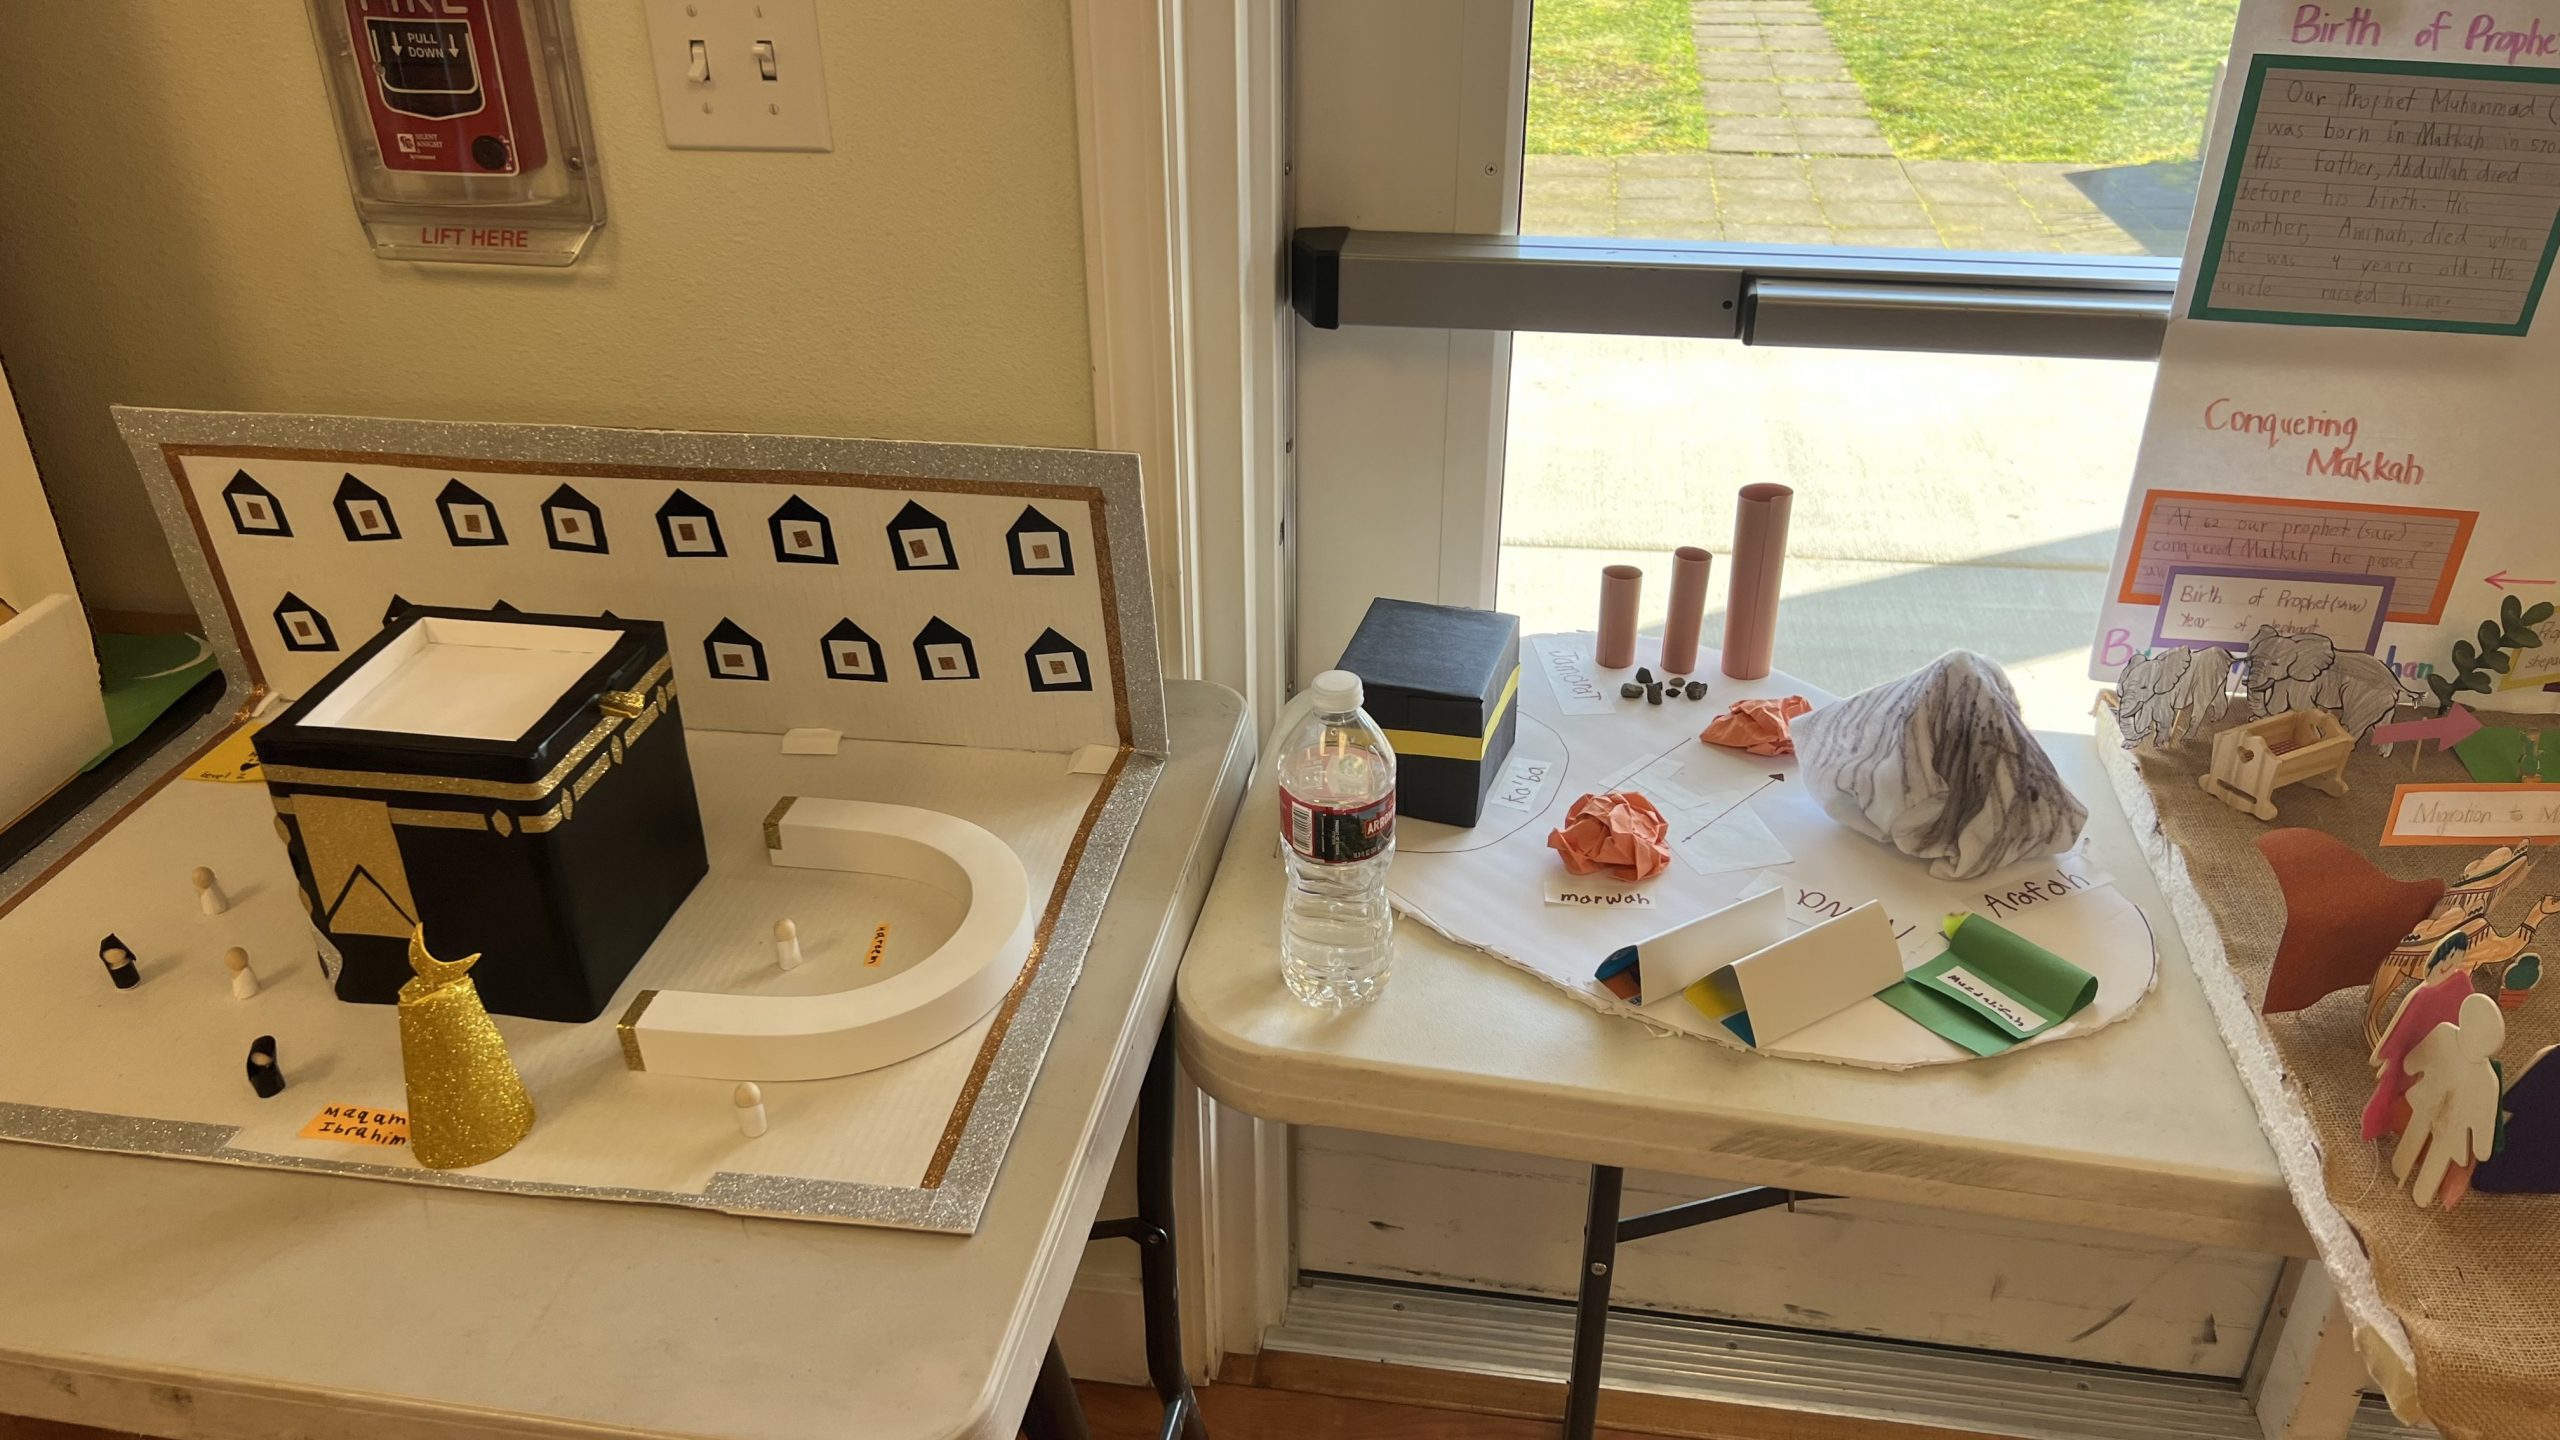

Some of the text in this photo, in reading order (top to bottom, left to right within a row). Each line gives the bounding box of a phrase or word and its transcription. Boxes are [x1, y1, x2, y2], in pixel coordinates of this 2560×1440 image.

[407, 32, 438, 44] PULL
[2291, 4, 2560, 64] Birth of Prophe
[408, 46, 444, 58] DOWN
[2287, 80, 2326, 106] Our
[2345, 83, 2416, 118] Prophet
[2431, 88, 2536, 118] Muhammad
[2267, 122, 2304, 138] was
[2323, 116, 2369, 142] born
[2504, 132, 2520, 152] in
[2255, 144, 2283, 171] His
[2387, 155, 2467, 182] Abdullah
[2477, 161, 2521, 183] died
[2239, 180, 2301, 204] before
[2322, 183, 2349, 206] his
[2446, 190, 2470, 214] His
[421, 227, 529, 248] LIFT HERE
[2236, 212, 2310, 244] mother,
[2423, 220, 2468, 246] died
[2488, 228, 2527, 250] when
[2227, 241, 2246, 263] he
[2266, 253, 2296, 267] was
[2361, 260, 2413, 278] years
[2491, 258, 2514, 280] His
[2222, 275, 2272, 297] uncle
[2321, 281, 2377, 304] raised
[2204, 398, 2359, 450] Conquering
[2306, 447, 2425, 485] Makkah
[2168, 506, 2192, 531] At
[2237, 519, 2270, 533] our
[2281, 517, 2350, 543] prophet
[2241, 538, 2308, 562] Makkah
[2330, 546, 2352, 564] he
[2365, 551, 2418, 575] passed
[2179, 585, 2222, 605] Birth
[2248, 586, 2268, 606] of
[2180, 612, 2321, 634] Year of lephant
[2409, 801, 2492, 834] Migration
[1560, 890, 1650, 906] marwah
[1984, 869, 2090, 919] Arafah
[318, 1121, 406, 1145] Ibrahim
[324, 1106, 406, 1125] Maqam
